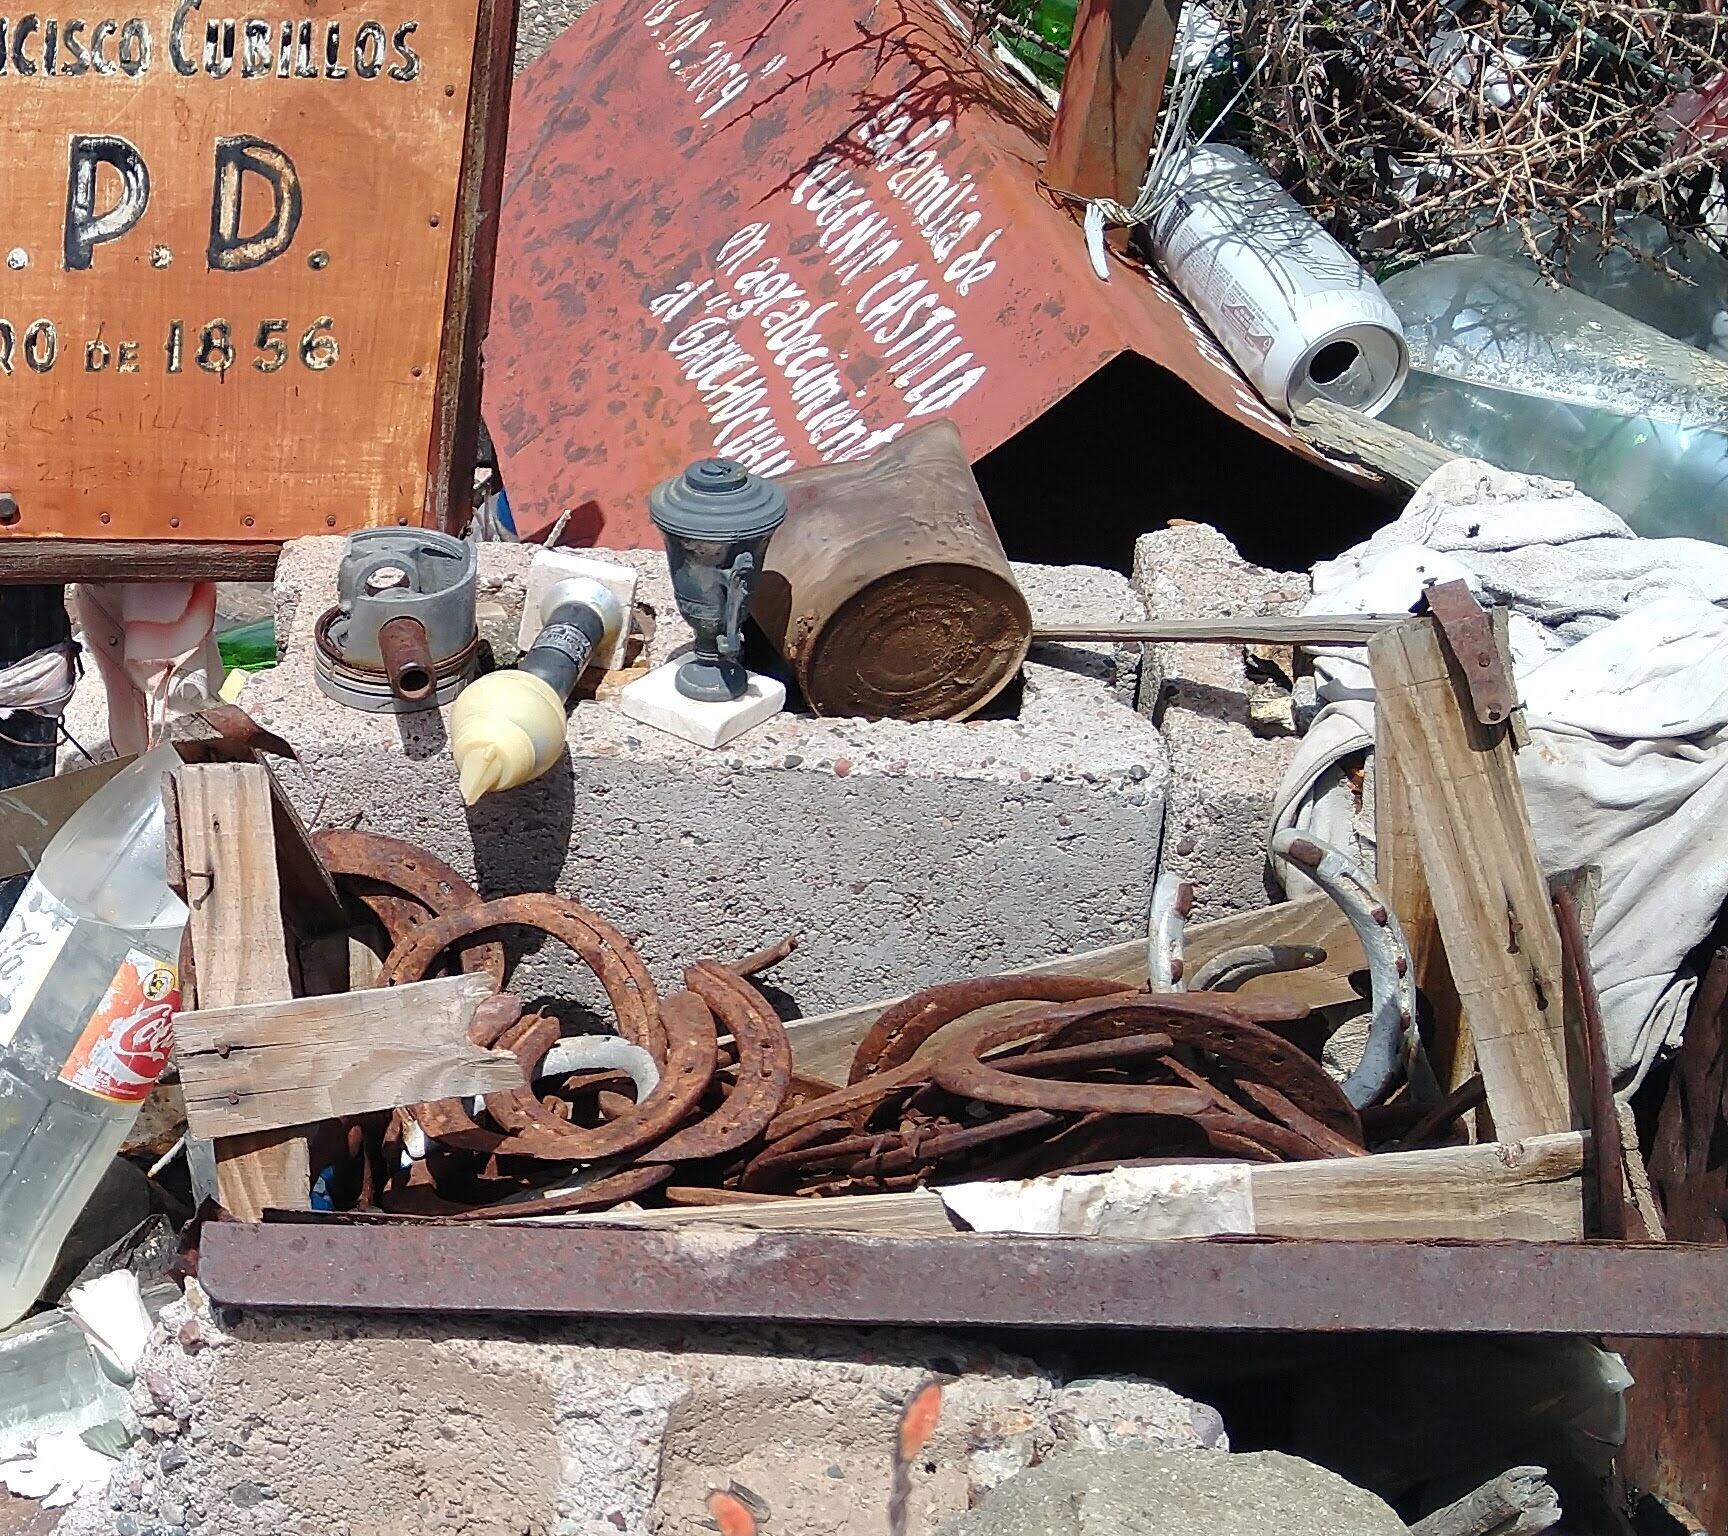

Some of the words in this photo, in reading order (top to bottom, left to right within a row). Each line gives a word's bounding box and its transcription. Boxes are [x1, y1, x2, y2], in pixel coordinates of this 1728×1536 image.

[943, 228, 1003, 297] de
[164, 314, 341, 376] 1856
[726, 256, 906, 464] agradecimient
[855, 262, 988, 419] CASTILLO
